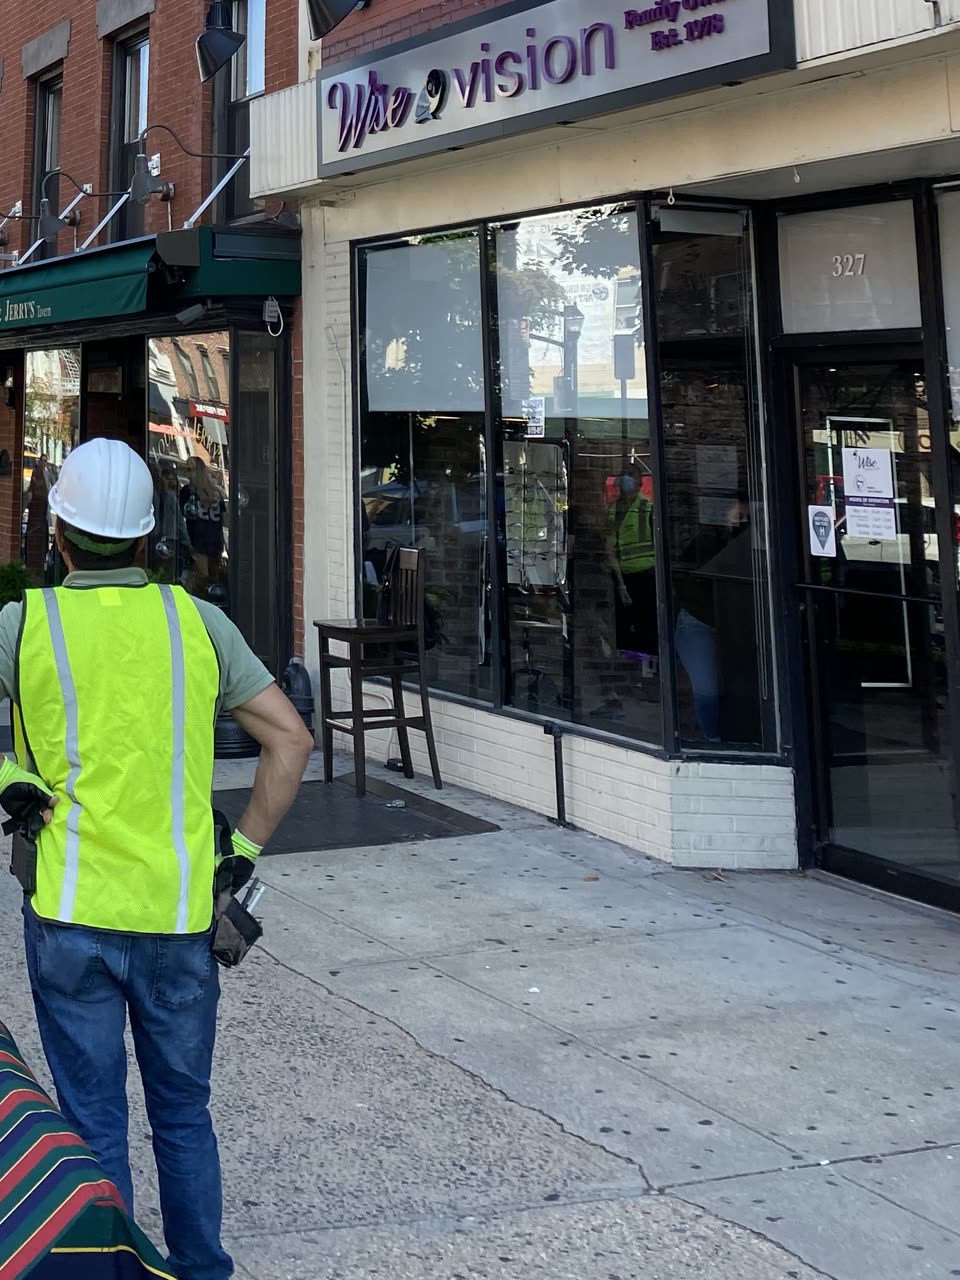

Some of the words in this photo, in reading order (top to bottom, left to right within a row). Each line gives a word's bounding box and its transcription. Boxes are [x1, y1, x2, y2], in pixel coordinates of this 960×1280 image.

[650, 28, 683, 51] Est.
[326, 70, 417, 152] Wise
[454, 21, 616, 108] vision
[832, 254, 865, 277] 327
[4, 300, 35, 322] JERRY'S
